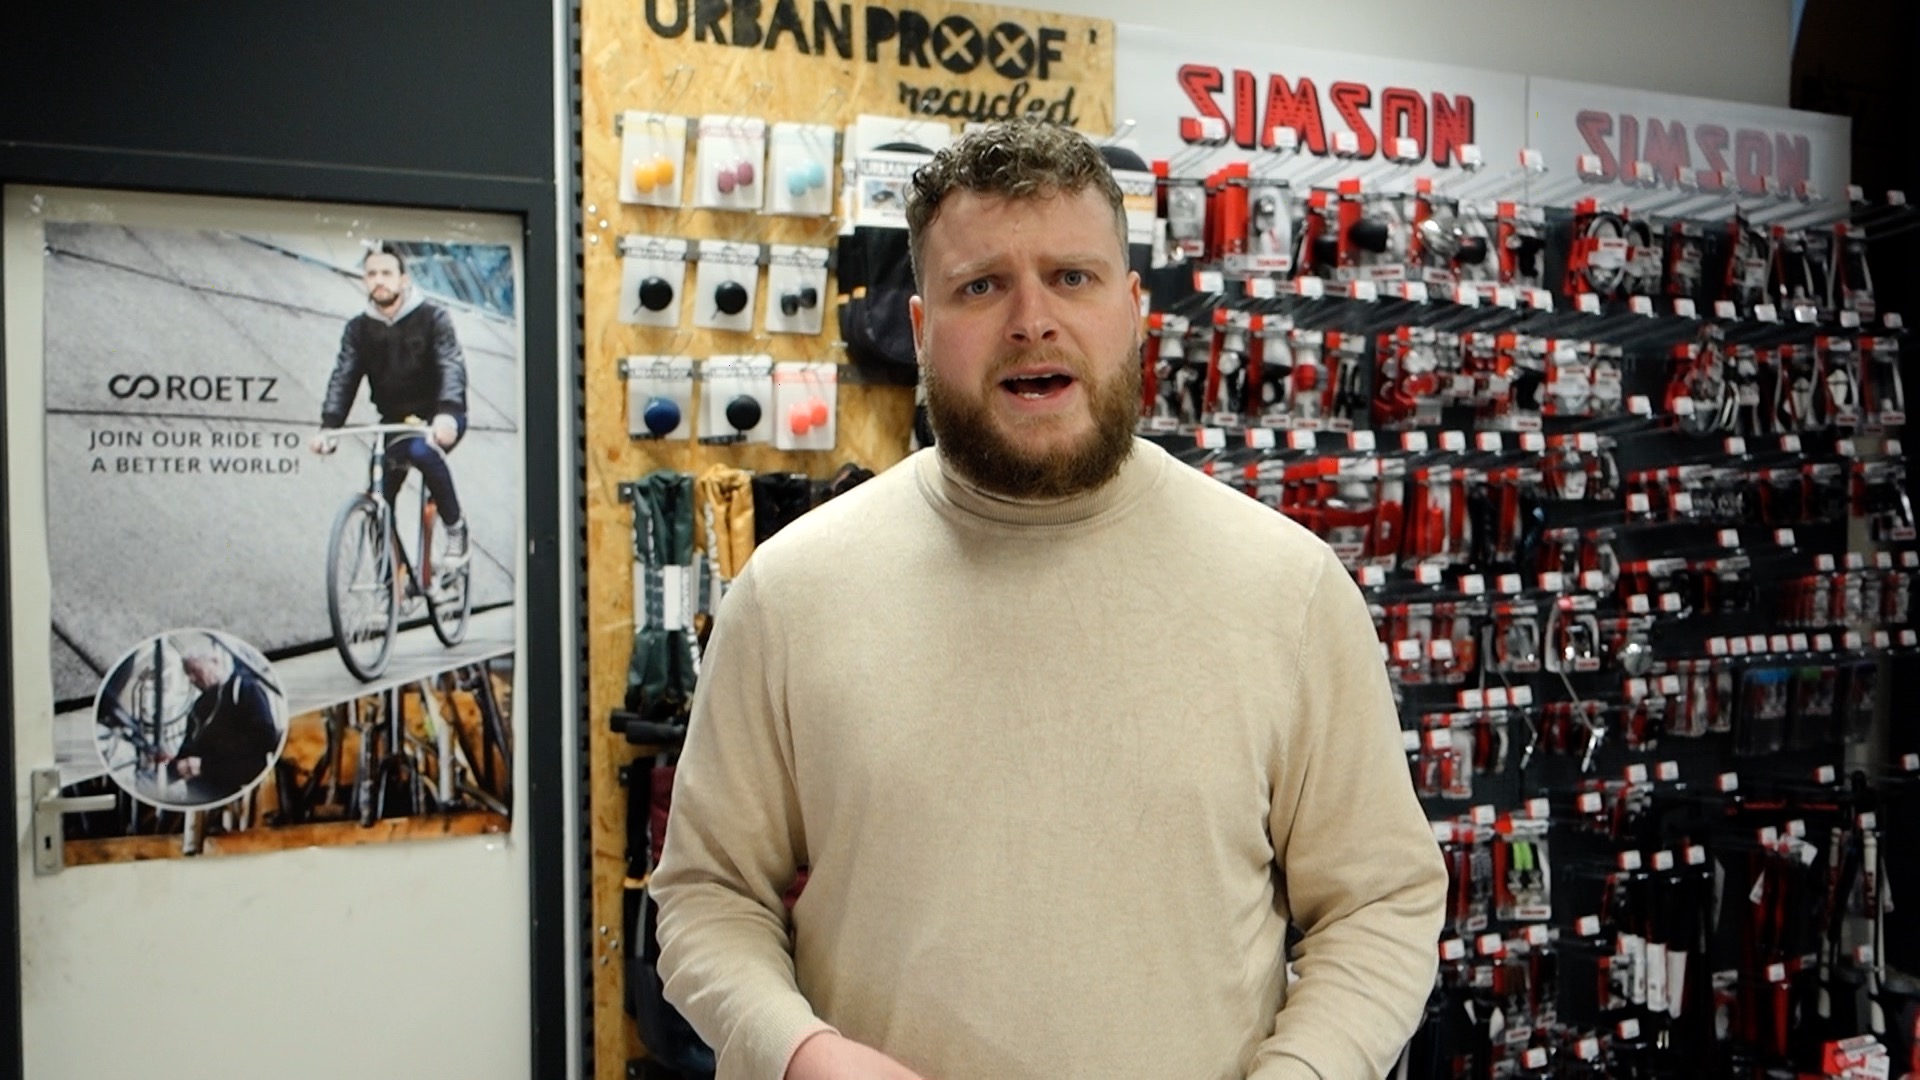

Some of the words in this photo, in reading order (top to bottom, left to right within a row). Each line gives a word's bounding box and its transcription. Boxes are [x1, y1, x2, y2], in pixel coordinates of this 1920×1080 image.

[645, 0, 853, 60] URBAN
[866, 6, 1066, 80] PROOF
[898, 79, 1079, 127] recycled
[1178, 63, 1475, 170] SIMSON
[1576, 109, 1811, 203] SIMSON
[166, 375, 278, 402] ROETZ
[89, 430, 142, 450] JOIN
[152, 430, 202, 448] OUR
[211, 431, 262, 448] RIDE
[271, 432, 300, 449] TO
[91, 457, 106, 474] A
[116, 457, 201, 474] BETTER
[209, 457, 300, 475] WORLD!
